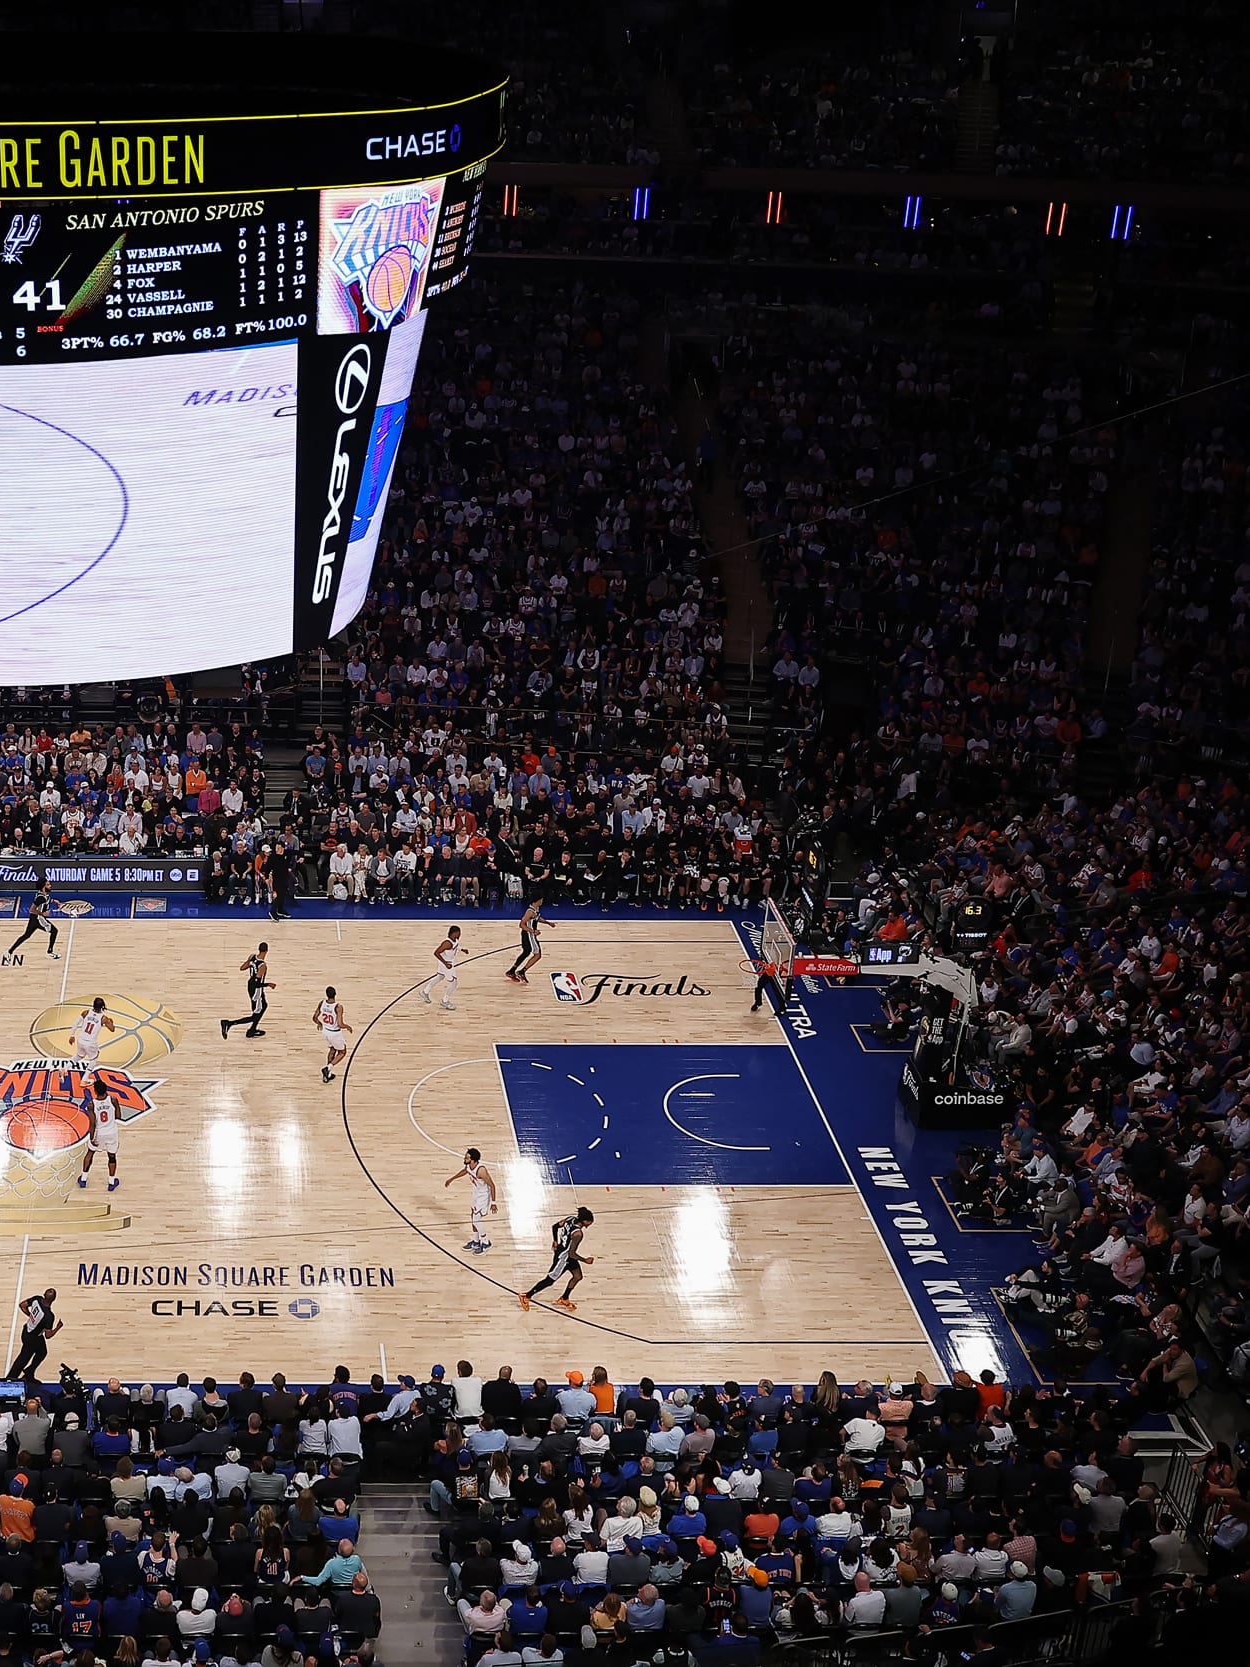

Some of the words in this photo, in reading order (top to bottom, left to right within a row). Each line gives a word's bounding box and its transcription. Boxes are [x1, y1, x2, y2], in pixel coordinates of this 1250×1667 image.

[366, 129, 447, 161] CHASE
[58, 129, 206, 188] GARDEN
[65, 213, 107, 230] SAN
[110, 206, 200, 228] ANTONIO
[205, 200, 265, 222] SPURS
[239, 227, 247, 237] F
[258, 225, 267, 235] A
[277, 222, 286, 232] R
[296, 219, 305, 229] P
[341, 198, 430, 258] KNICKS
[114, 250, 122, 261] 1
[126, 242, 223, 261] WEMBANYAMA
[238, 239, 247, 249] 0
[259, 237, 266, 247] 1
[277, 235, 286, 245] 3
[293, 231, 308, 242] 13
[112, 265, 122, 275] 2
[126, 260, 182, 275] HARPER
[257, 251, 266, 262] 2
[295, 246, 304, 257] 2
[113, 279, 122, 290] 4
[127, 277, 156, 289] FOX
[295, 261, 304, 271] 5
[13, 280, 66, 312] 41
[105, 294, 122, 305] 24
[127, 289, 186, 304] VASSELL
[257, 280, 266, 291] 2
[292, 274, 306, 285] 12
[106, 309, 123, 320] 30
[127, 300, 215, 318] CHAMPAGNIE
[294, 289, 303, 300] 2
[15, 327, 25, 339] 5
[37, 325, 65, 333] BONUS
[61, 336, 104, 350] 3PT%
[109, 333, 146, 348] 66.7
[152, 330, 186, 344] FG%
[192, 326, 227, 340] 68.2
[235, 320, 266, 335] FT%
[267, 313, 307, 331] 100.0
[16, 345, 26, 357] 6
[183, 384, 297, 406] MADIS
[312, 418, 357, 604] LEXUS
[45, 868, 86, 882] SATURDAY
[90, 868, 114, 882] GAME
[115, 868, 121, 882] 5
[579, 974, 712, 1006] Finals
[85, 1022, 95, 1034] 11
[322, 1013, 334, 1025] 20
[931, 1026, 943, 1035] THE
[932, 1018, 945, 1026] GET
[12, 1060, 48, 1071] NEW
[934, 1092, 1004, 1106] coinbase
[100, 1111, 109, 1123] 8
[857, 1146, 910, 1190] NEW
[885, 1201, 949, 1266] YORK
[77, 1263, 188, 1287] MADISON
[198, 1263, 291, 1289] SQUARE
[300, 1264, 395, 1288] GARDEN
[151, 1300, 280, 1317] CHASE
[71, 1620, 93, 1633] 17
